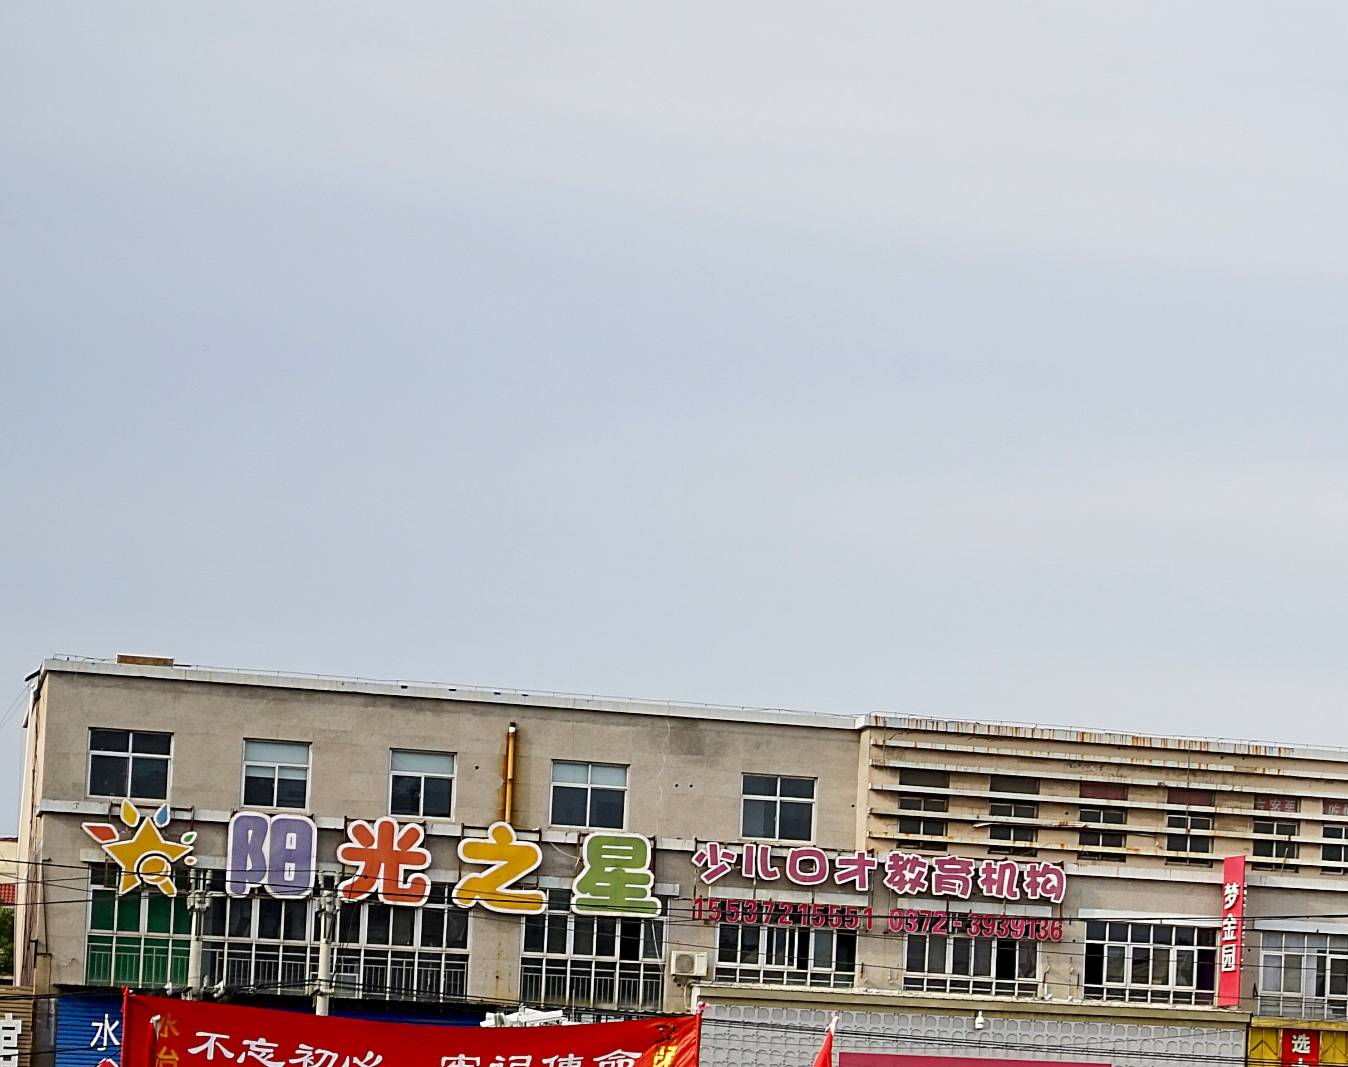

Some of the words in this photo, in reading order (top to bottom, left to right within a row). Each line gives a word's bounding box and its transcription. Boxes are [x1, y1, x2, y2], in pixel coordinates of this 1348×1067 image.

[227, 812, 662, 917] 阳光之星
[692, 842, 1067, 904] 少儿口才教育机构
[888, 908, 1064, 942] 0372-3939136
[1221, 882, 1239, 972] 梦金园
